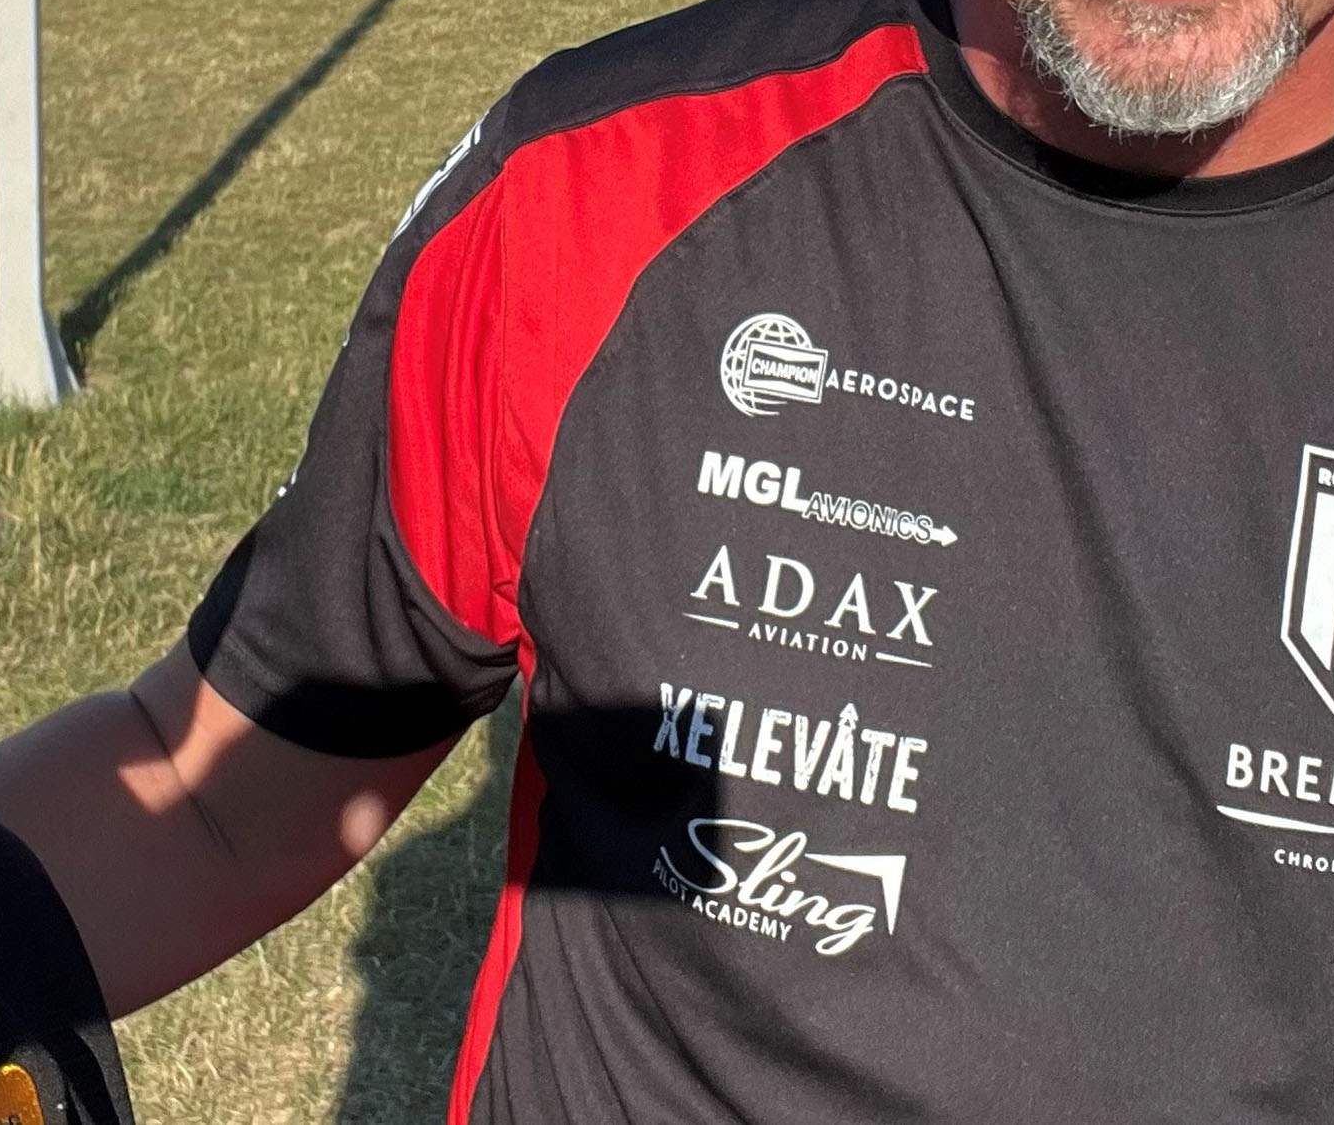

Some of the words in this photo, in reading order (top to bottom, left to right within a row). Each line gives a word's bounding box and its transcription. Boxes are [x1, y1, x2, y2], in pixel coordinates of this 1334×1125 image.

[751, 357, 819, 384] CHAMPION
[825, 368, 976, 422] AEROSPACE
[697, 450, 809, 512] MGL
[801, 491, 934, 544] AVIONICS
[690, 544, 939, 646] ADAX
[748, 622, 868, 662] AVIATION
[660, 818, 877, 956] Sling
[691, 895, 793, 944] ACADEMY
